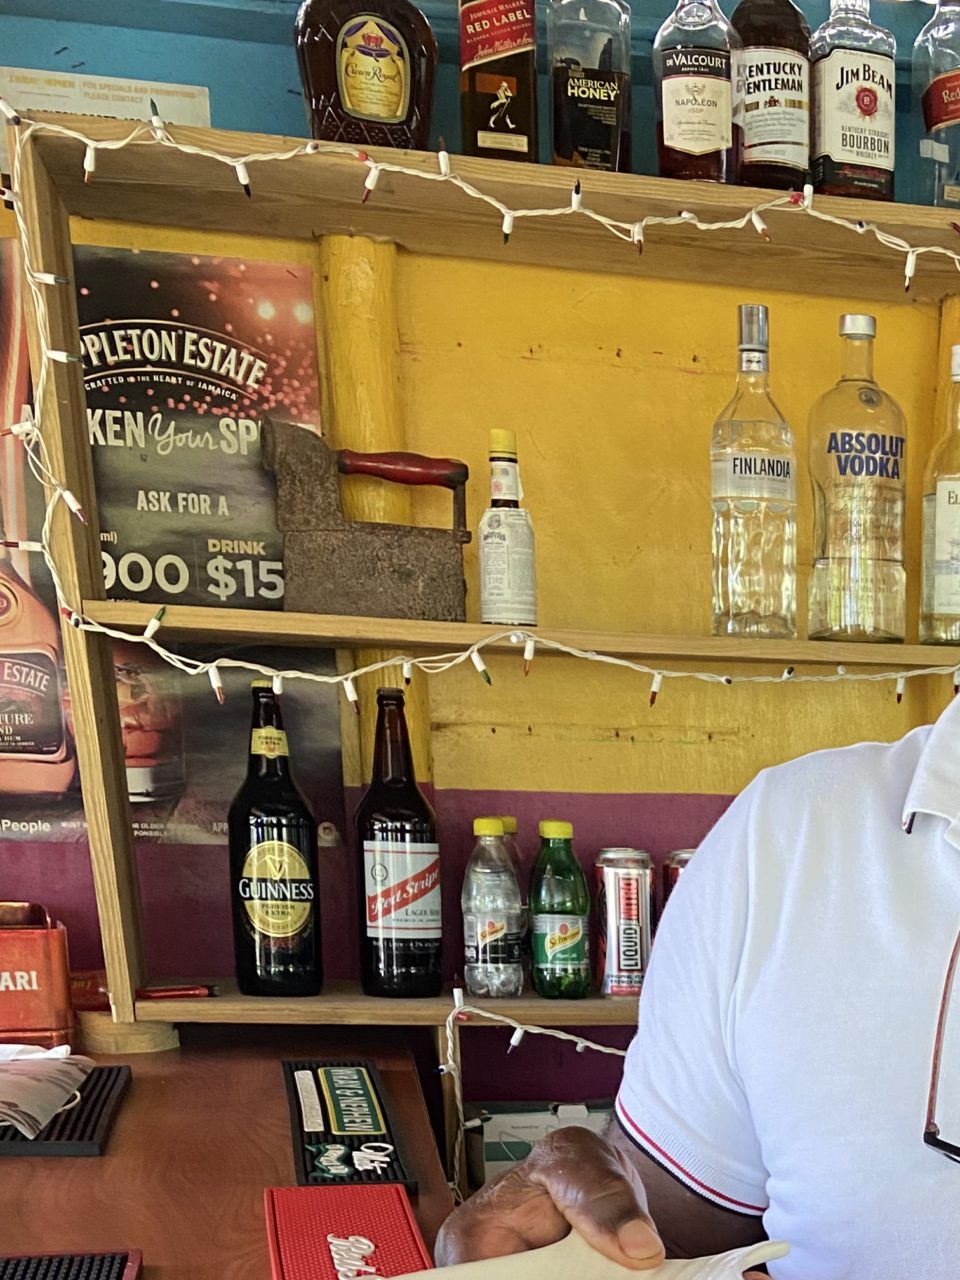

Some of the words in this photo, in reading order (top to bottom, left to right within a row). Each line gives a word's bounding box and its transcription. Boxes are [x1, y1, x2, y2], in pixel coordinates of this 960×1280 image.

[466, 19, 491, 34] RED
[493, 9, 531, 26] LABEL
[345, 63, 371, 78] Crown
[672, 54, 726, 68] VALCOURT
[736, 62, 803, 79] KENTUCKY
[567, 78, 618, 90] AMERICAN
[736, 79, 803, 95] GENTLEMAN
[835, 66, 860, 91] JIM
[862, 63, 893, 100] BEAM
[567, 86, 616, 101] HONEY
[841, 134, 890, 154] BOURBON
[183, 331, 268, 389] ESTATE
[84, 376, 124, 391] CRAFTED
[153, 374, 183, 385] HEART
[198, 381, 237, 401] JAMAICA
[148, 412, 218, 455] Your
[219, 417, 261, 456] SP
[827, 432, 905, 458] ABSOLUT
[733, 457, 791, 479] FINLANDIA
[836, 454, 900, 480] VODKA
[137, 490, 172, 512] ASK
[177, 493, 212, 516] FOR
[217, 495, 230, 516] A
[948, 491, 960, 505] EL
[207, 538, 267, 556] DRINK
[3, 662, 50, 692] ESTATE
[2, 819, 51, 834] People
[238, 879, 315, 900] GUINNESS
[371, 889, 403, 915] Red
[405, 908, 429, 917] LAGER
[621, 926, 639, 968] LIQUID
[331, 1066, 362, 1089] WRAY
[338, 1096, 375, 1132] NEPHEW
